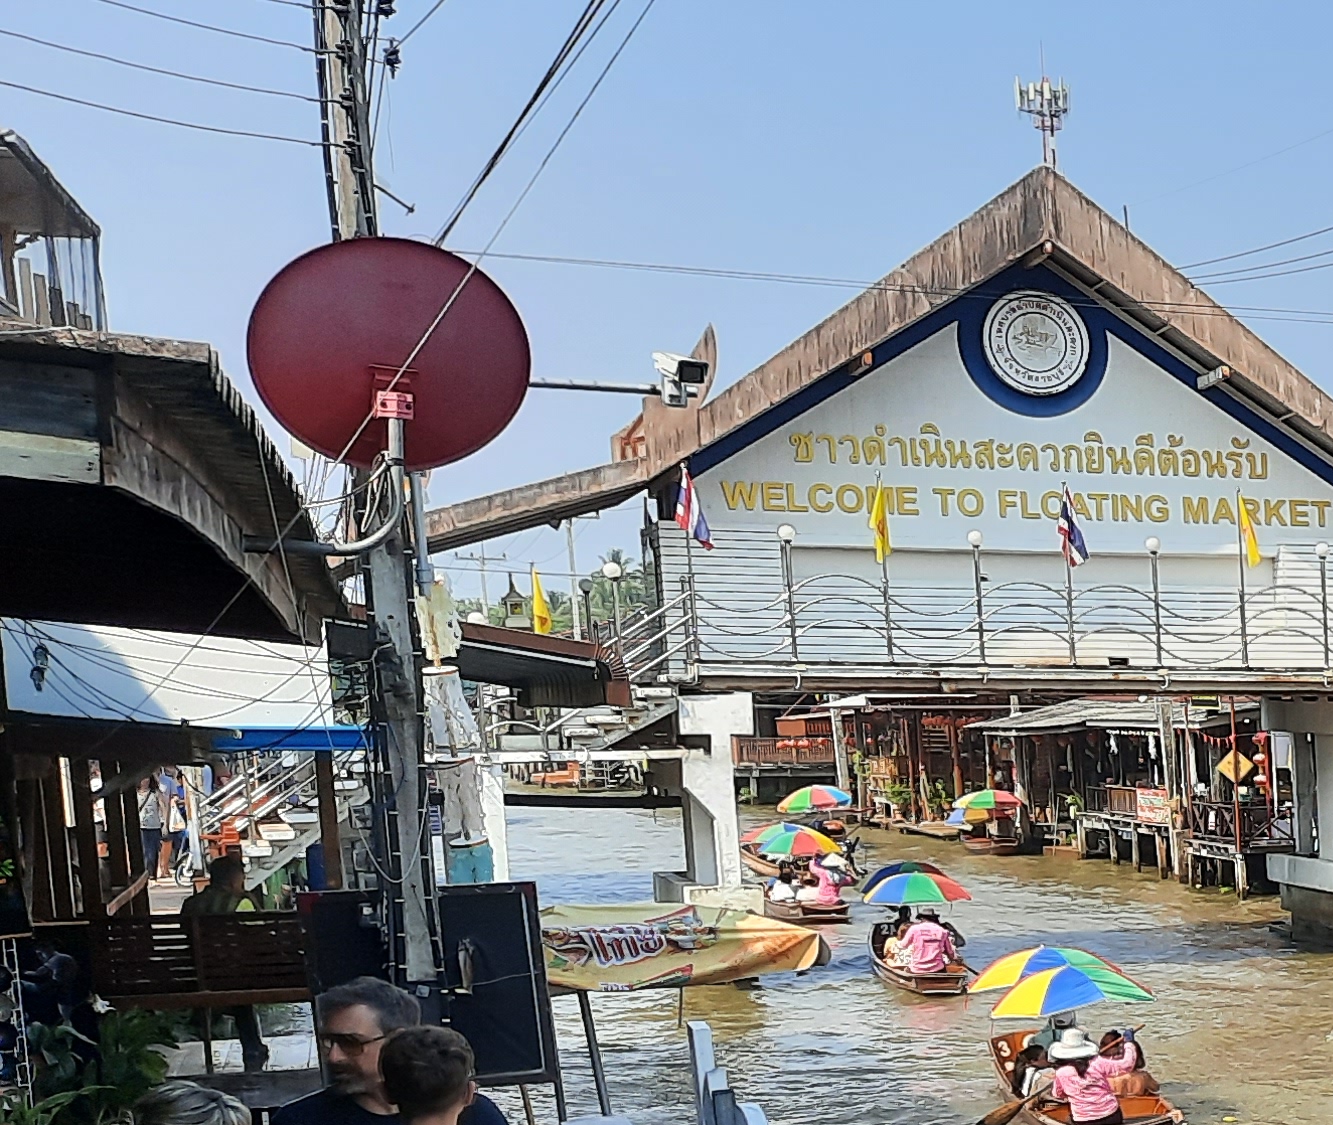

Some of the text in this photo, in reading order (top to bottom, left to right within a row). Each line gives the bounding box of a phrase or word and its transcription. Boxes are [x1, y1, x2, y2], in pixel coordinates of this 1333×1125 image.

[788, 422, 1269, 480] ชาวดำเนินสะดวกยินดีต้อนรับ
[720, 479, 1332, 528] WELCOME TO FLOATING MARKET
[997, 1040, 1011, 1057] 3
